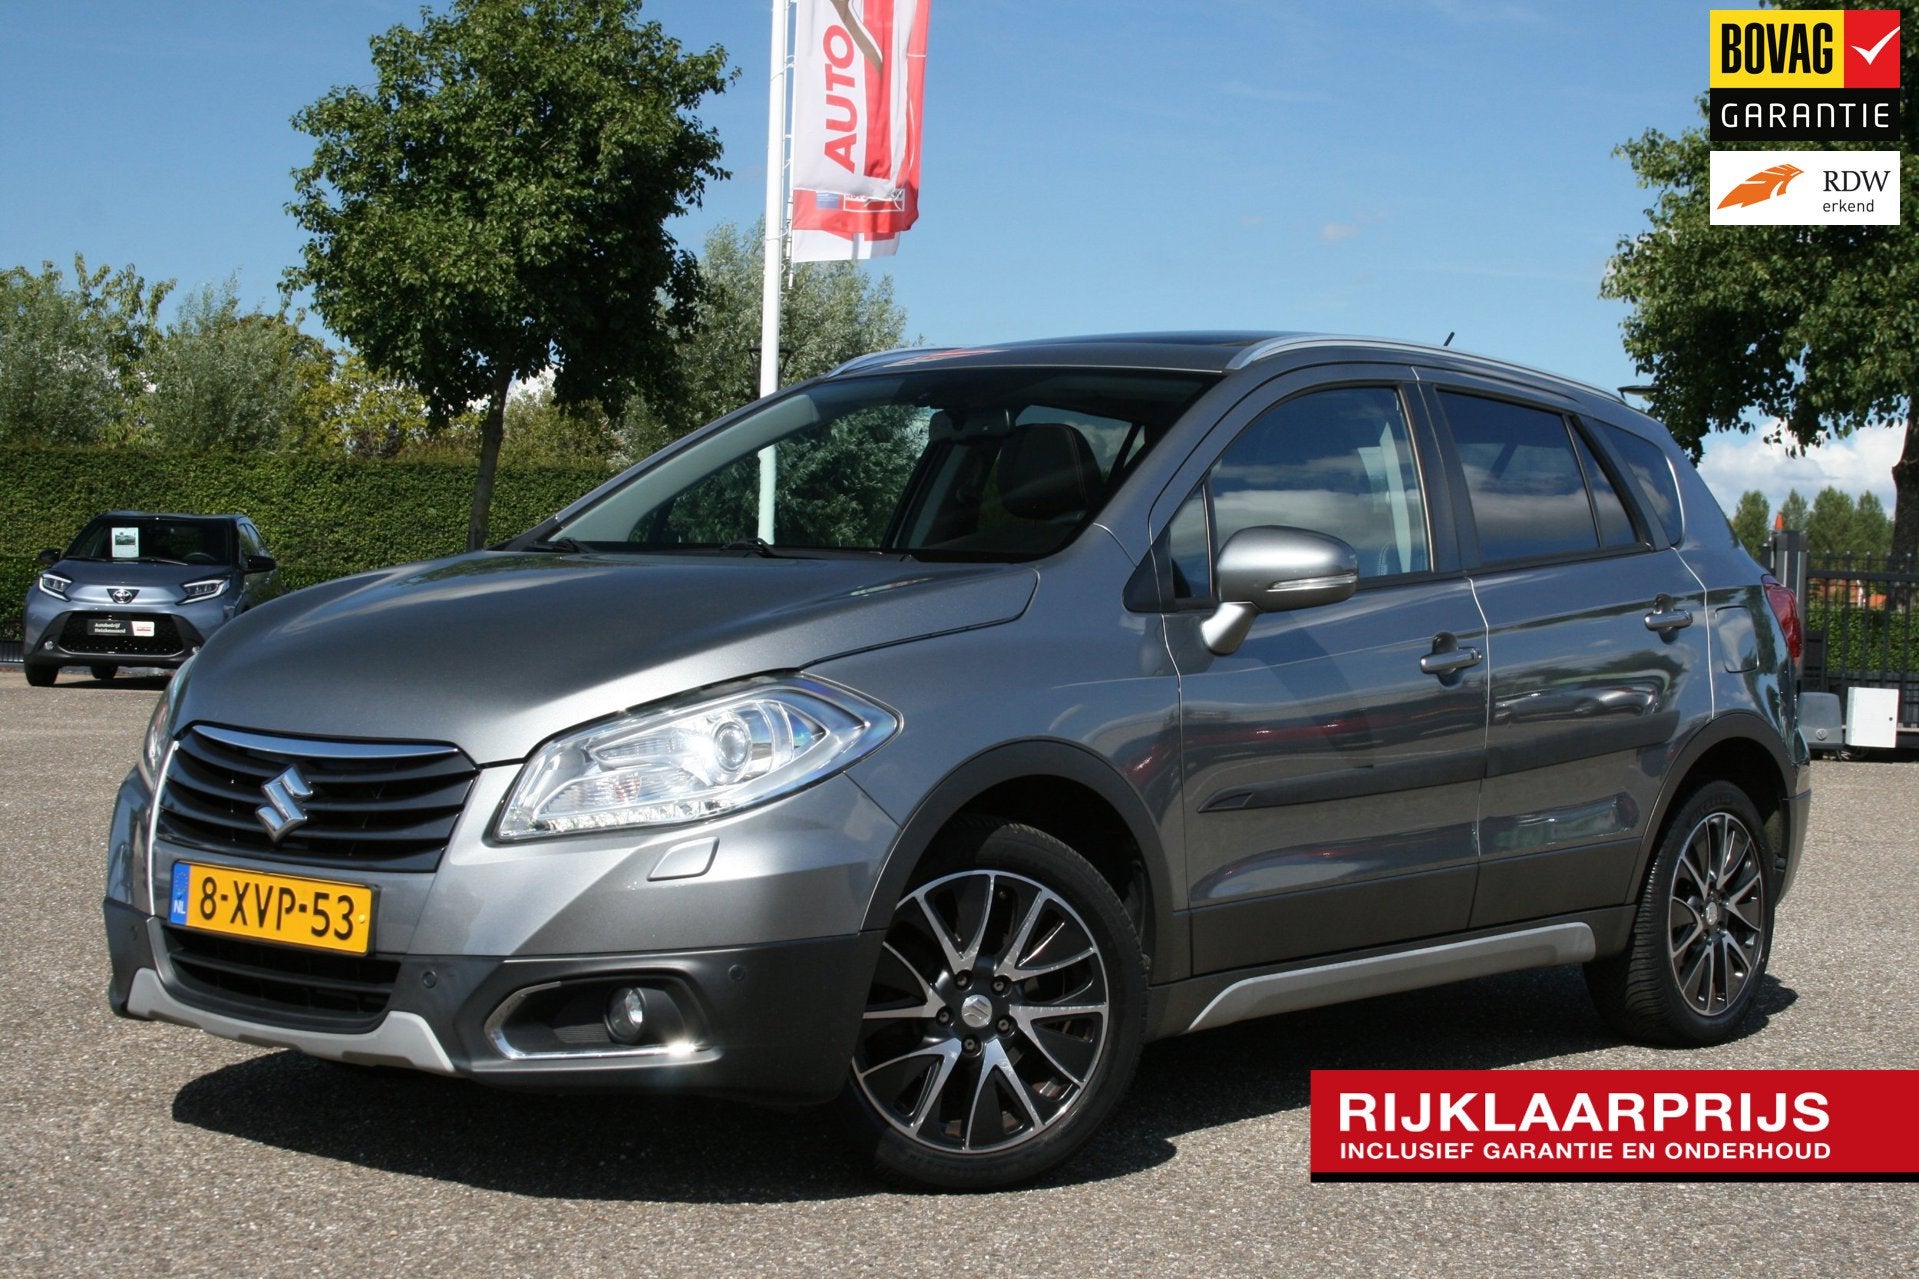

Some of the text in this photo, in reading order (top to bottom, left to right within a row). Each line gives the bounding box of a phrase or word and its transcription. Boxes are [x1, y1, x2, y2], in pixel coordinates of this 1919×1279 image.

[823, 25, 857, 174] AUTO
[173, 900, 186, 914] NL
[200, 876, 355, 941] 8-XVP-53
